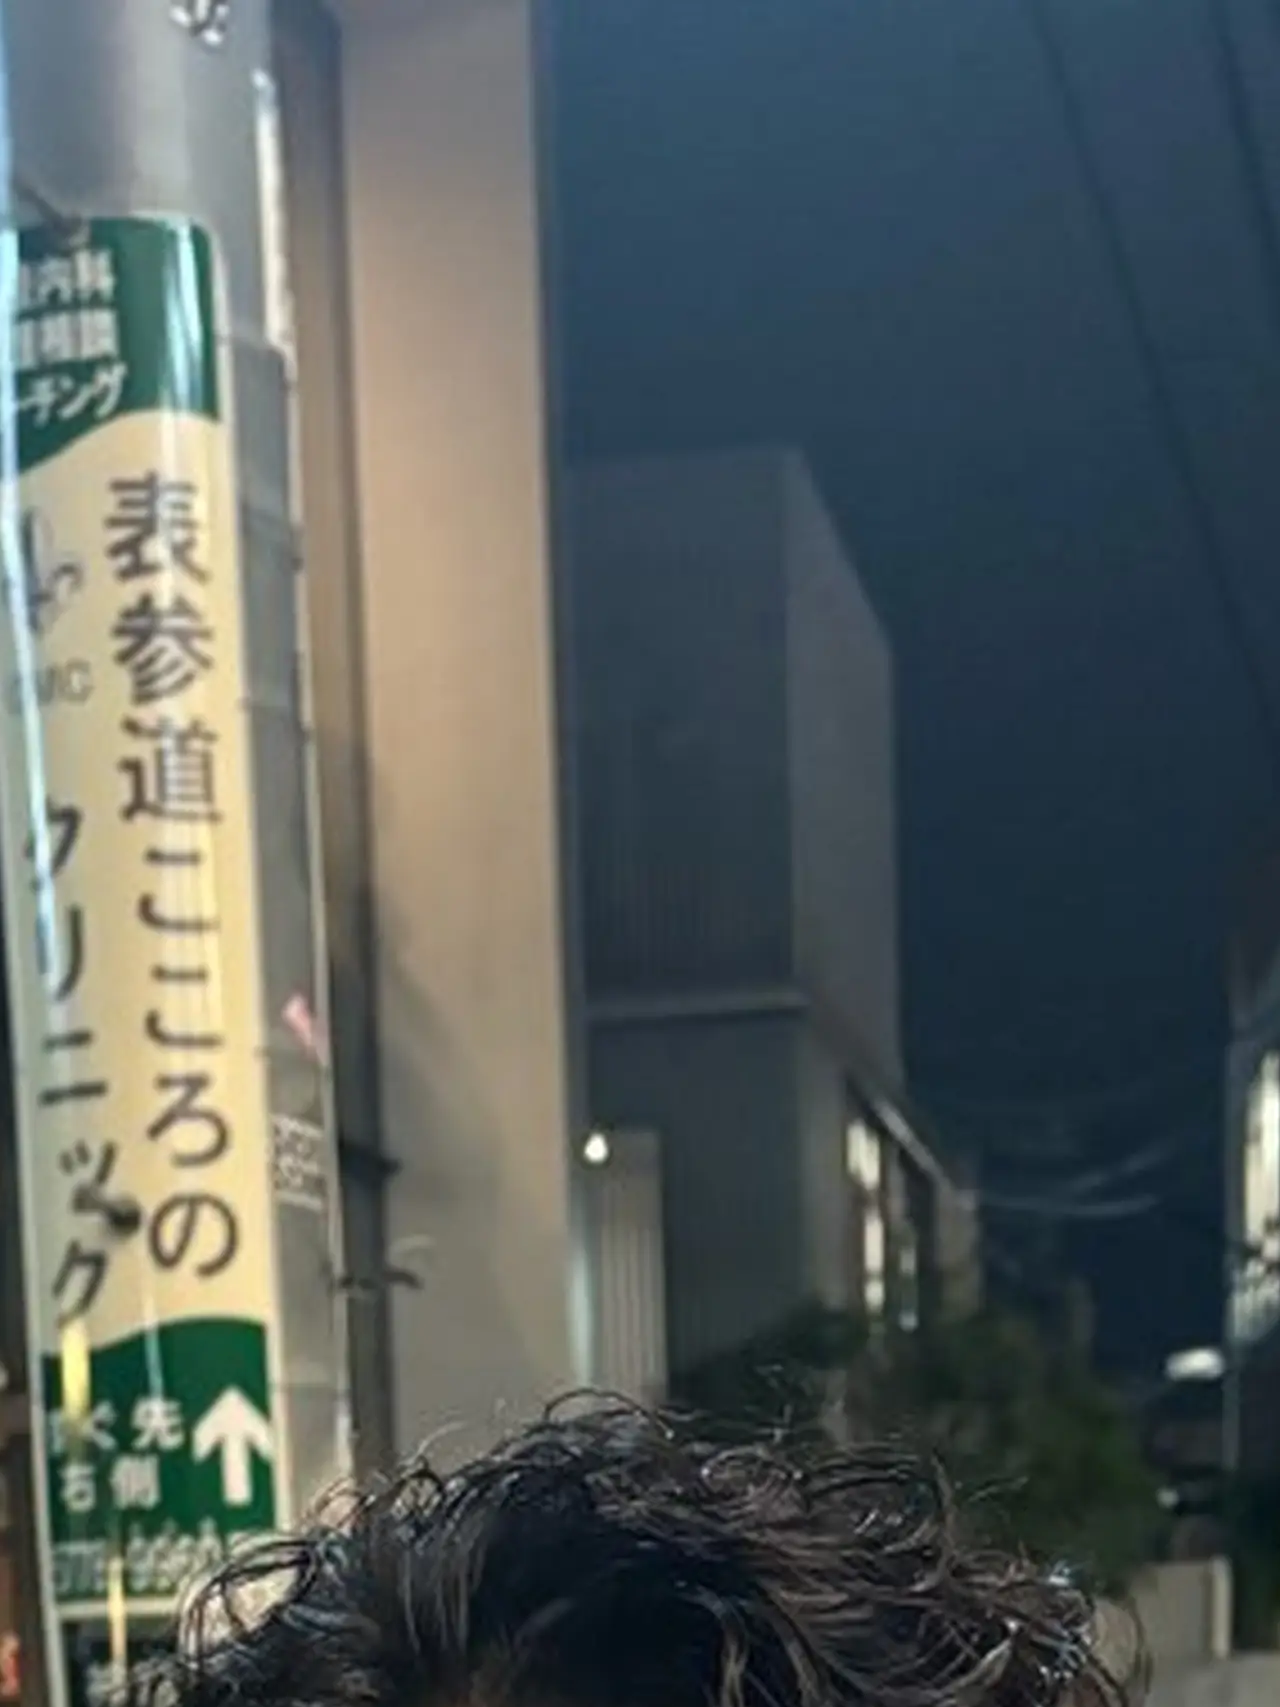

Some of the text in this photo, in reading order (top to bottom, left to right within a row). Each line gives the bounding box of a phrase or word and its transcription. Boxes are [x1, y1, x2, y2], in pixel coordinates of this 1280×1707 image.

[23, 803, 119, 1322] クリニック
[104, 472, 239, 1276] 表参道こころの
